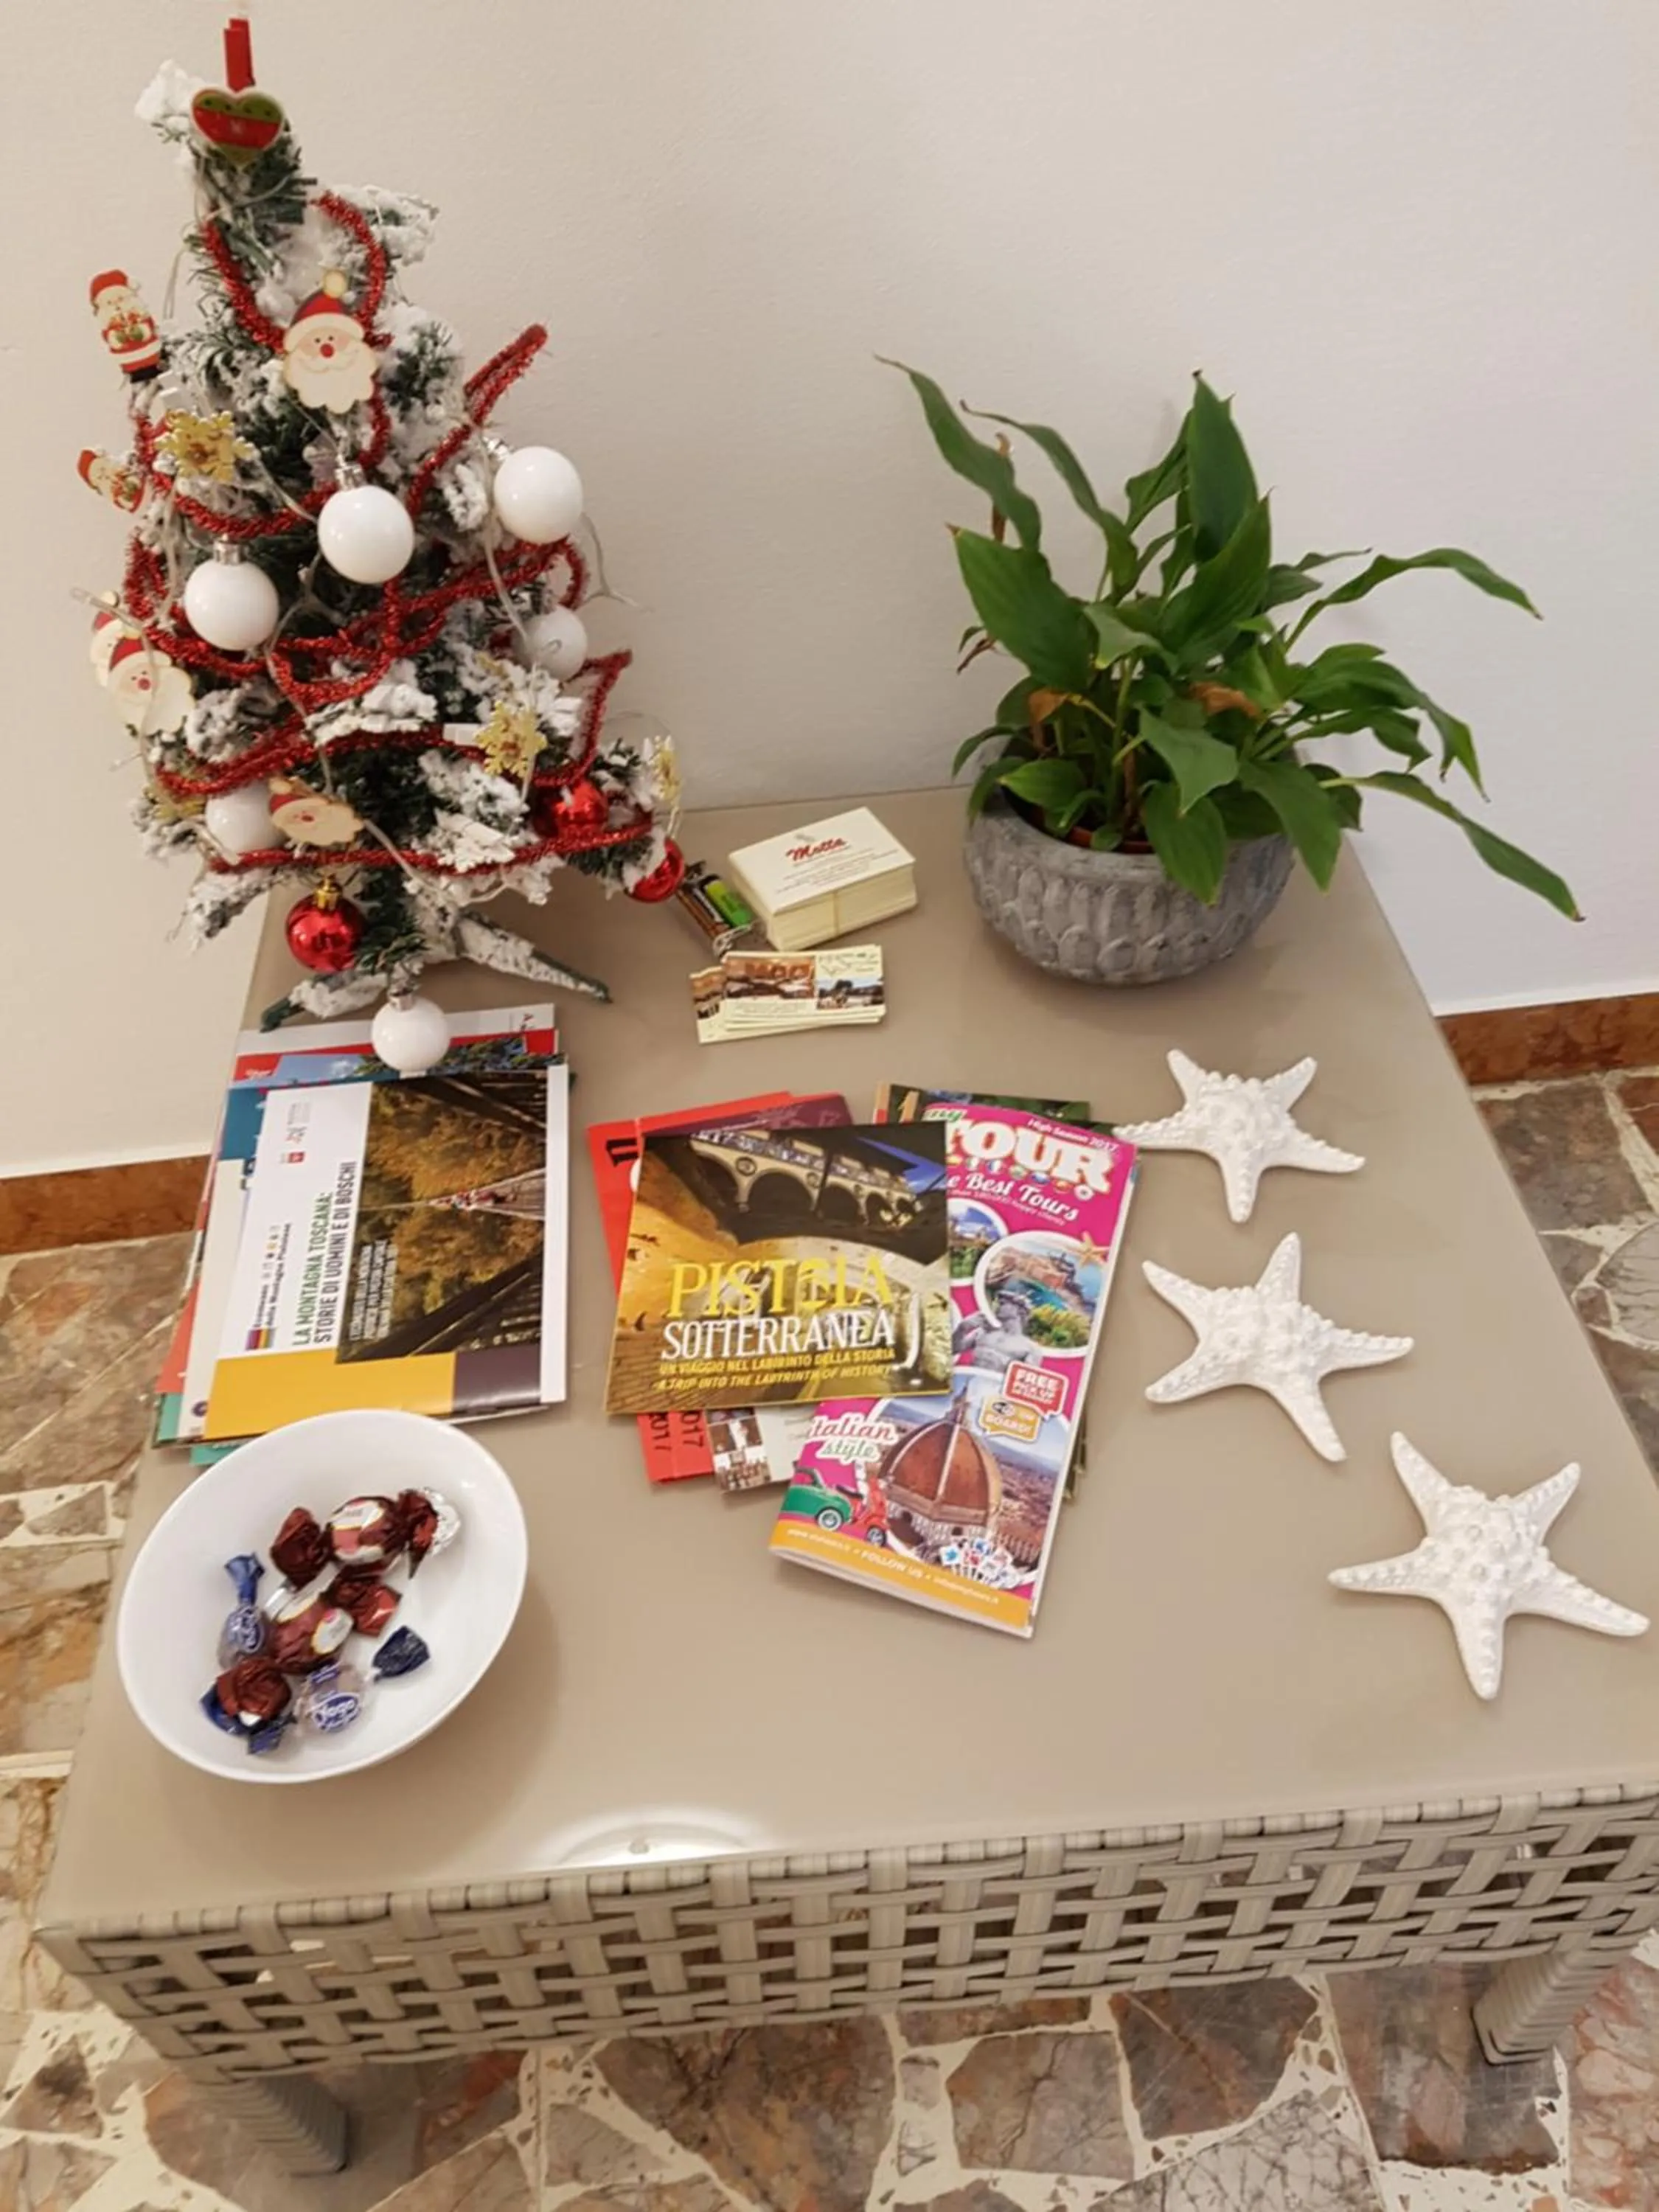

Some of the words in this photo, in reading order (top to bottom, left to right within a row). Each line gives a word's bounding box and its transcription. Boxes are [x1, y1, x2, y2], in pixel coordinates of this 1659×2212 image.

[335, 1161, 357, 1206] BOSCHI
[965, 1172, 1015, 1197] Best
[1018, 1183, 1079, 1222] Tours
[332, 1222, 349, 1231] E
[333, 1206, 350, 1222] DI
[324, 1232, 347, 1275] UOMINI
[296, 1254, 323, 1324] MONTAGNA
[321, 1278, 339, 1293] DI
[315, 1296, 338, 1343] STORIE
[292, 1325, 311, 1346] LA
[661, 1309, 895, 1360] SOTTERRANEA
[679, 1359, 726, 1375] VIAGGIO
[726, 1359, 751, 1372] NEL
[751, 1354, 812, 1371] LABIRINTO
[814, 1352, 851, 1365] DELLA
[854, 1347, 895, 1363] STORIA
[698, 1374, 728, 1389] INTO
[730, 1373, 752, 1387] THE
[754, 1368, 821, 1385] LABYRINTH
[821, 1366, 838, 1380] OF
[840, 1363, 891, 1378] HISTORY
[810, 1413, 894, 1440] Italian
[820, 1437, 880, 1462] style
